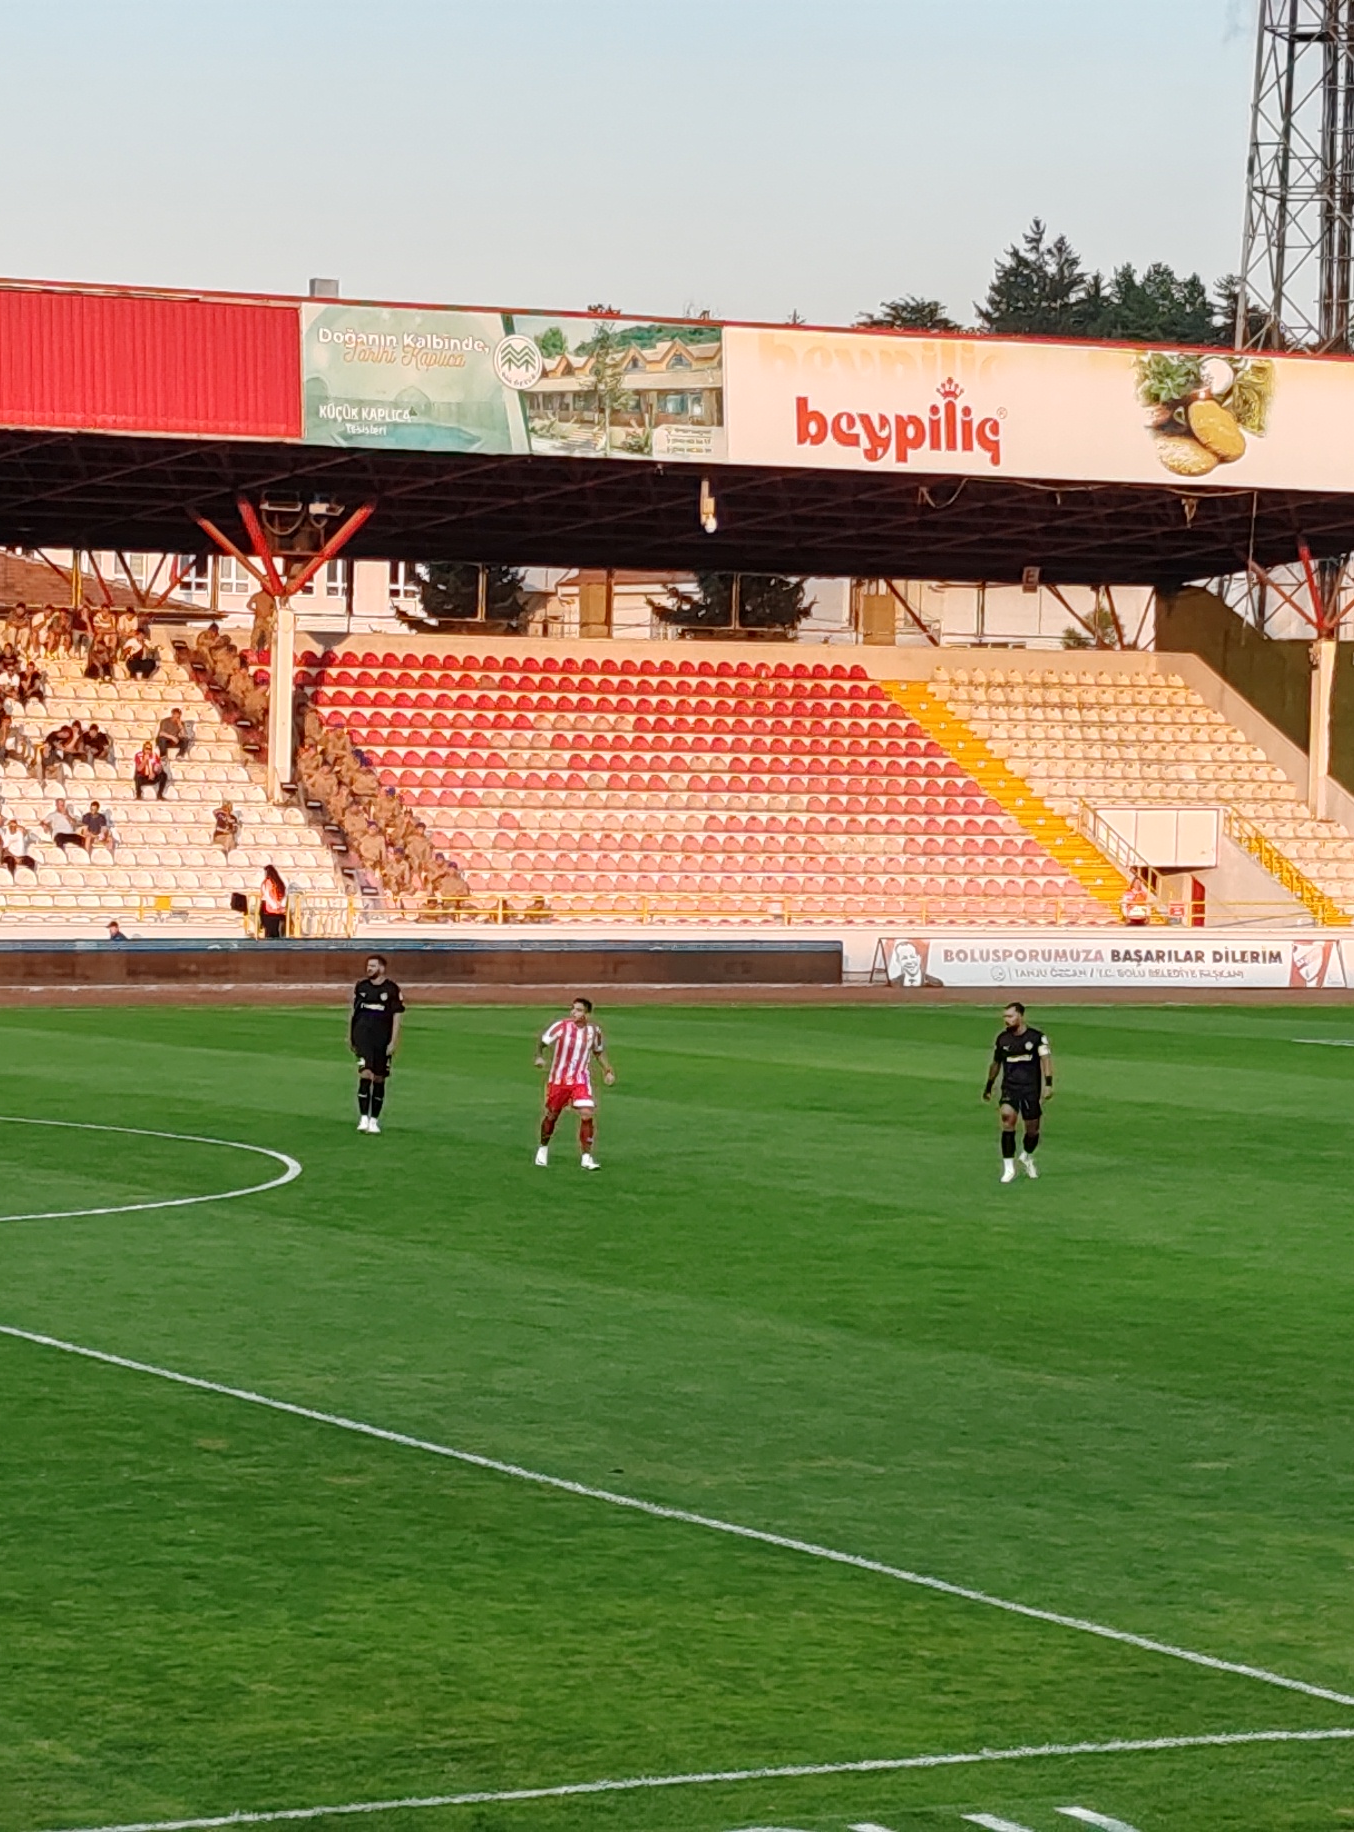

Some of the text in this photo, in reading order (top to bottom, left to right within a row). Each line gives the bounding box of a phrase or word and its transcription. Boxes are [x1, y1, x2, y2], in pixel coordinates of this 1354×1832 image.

[318, 328, 490, 354] Doğanın Kalbinde,
[344, 342, 466, 371] Tarihi Kaplıca
[319, 403, 412, 423] KÜÇÜK KAPLICA
[943, 946, 1283, 967] BOLUSPORUMUZA BAŞARILAR DİLERİM
